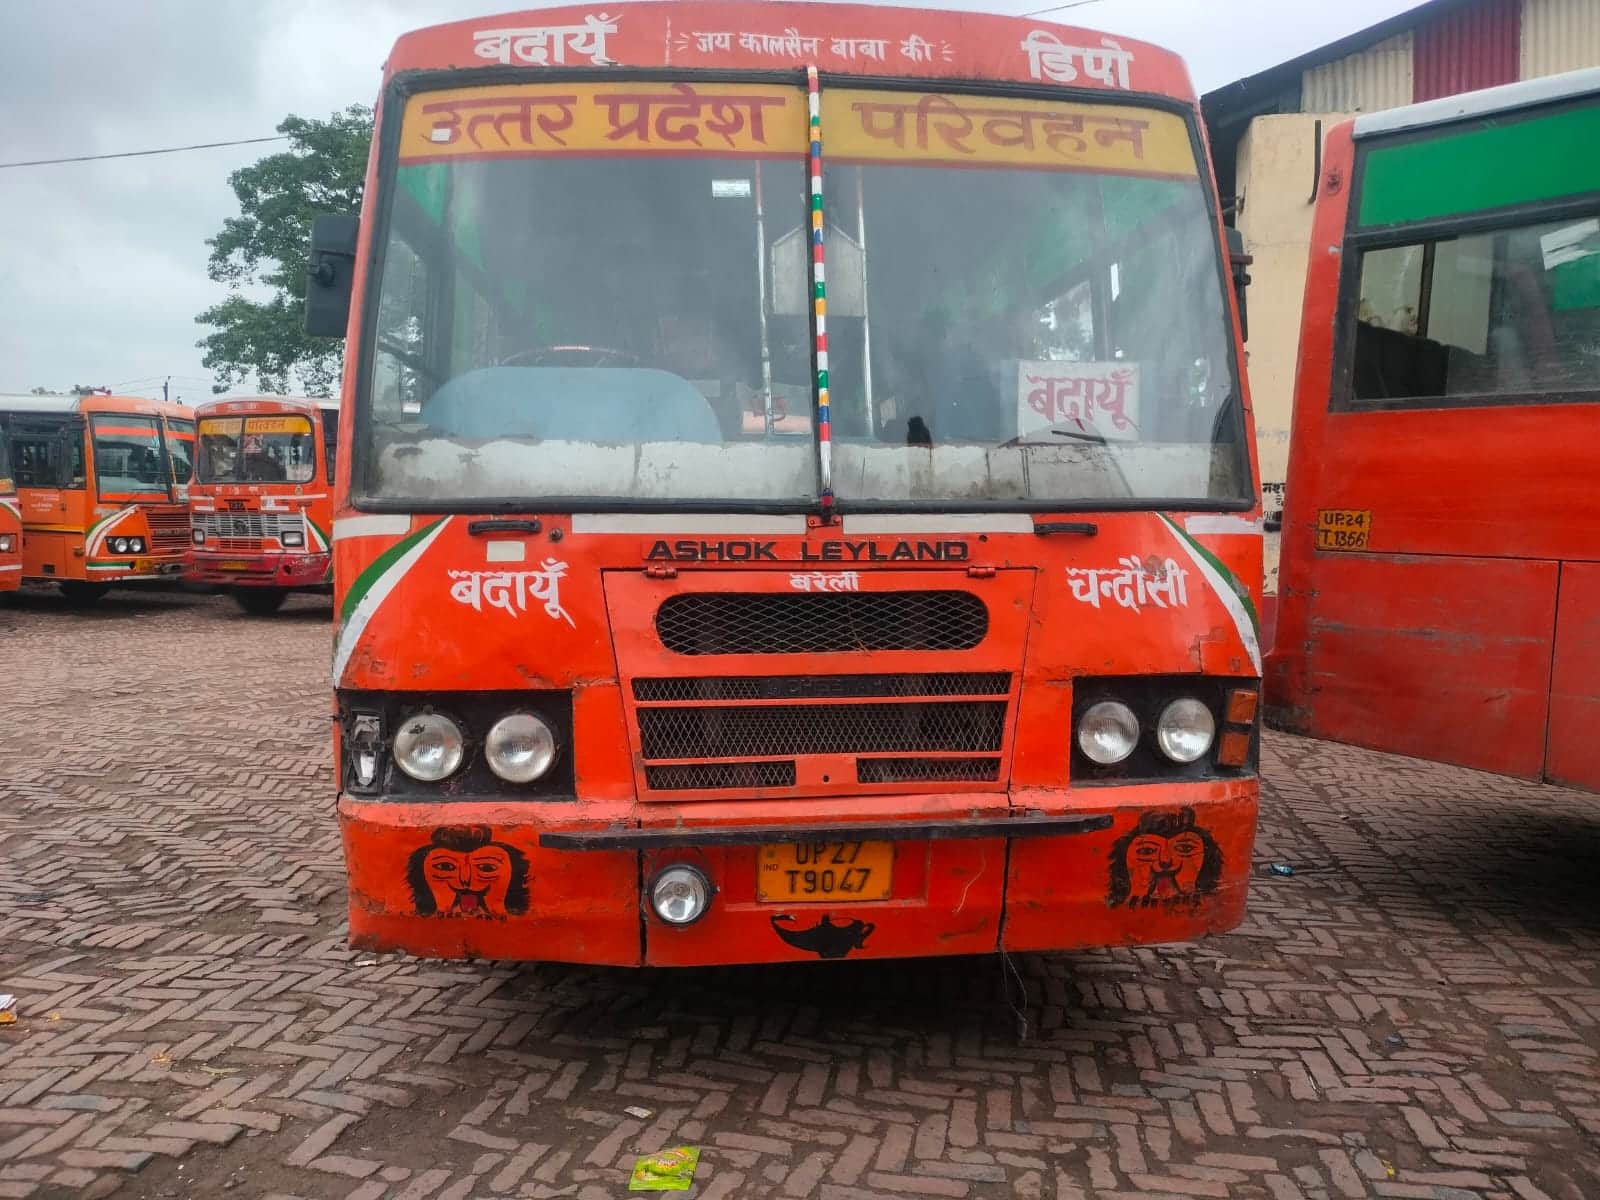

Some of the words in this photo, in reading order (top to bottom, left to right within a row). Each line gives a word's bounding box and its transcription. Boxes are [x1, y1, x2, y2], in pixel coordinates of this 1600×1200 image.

[473, 13, 622, 66] बदायूँ
[692, 32, 735, 53] जय
[831, 37, 891, 61] बाबा
[900, 33, 936, 61] की
[1020, 29, 1133, 91] डिपो
[421, 95, 577, 148] उत्तर
[594, 83, 785, 148] प्रदेश
[851, 94, 1149, 160] परिवहन
[1026, 368, 1141, 432] बदायूँ
[650, 540, 777, 560] ASHOK
[801, 539, 968, 560] LEYLAND
[448, 557, 576, 629] बदायूँ
[785, 868, 871, 893] T9047
